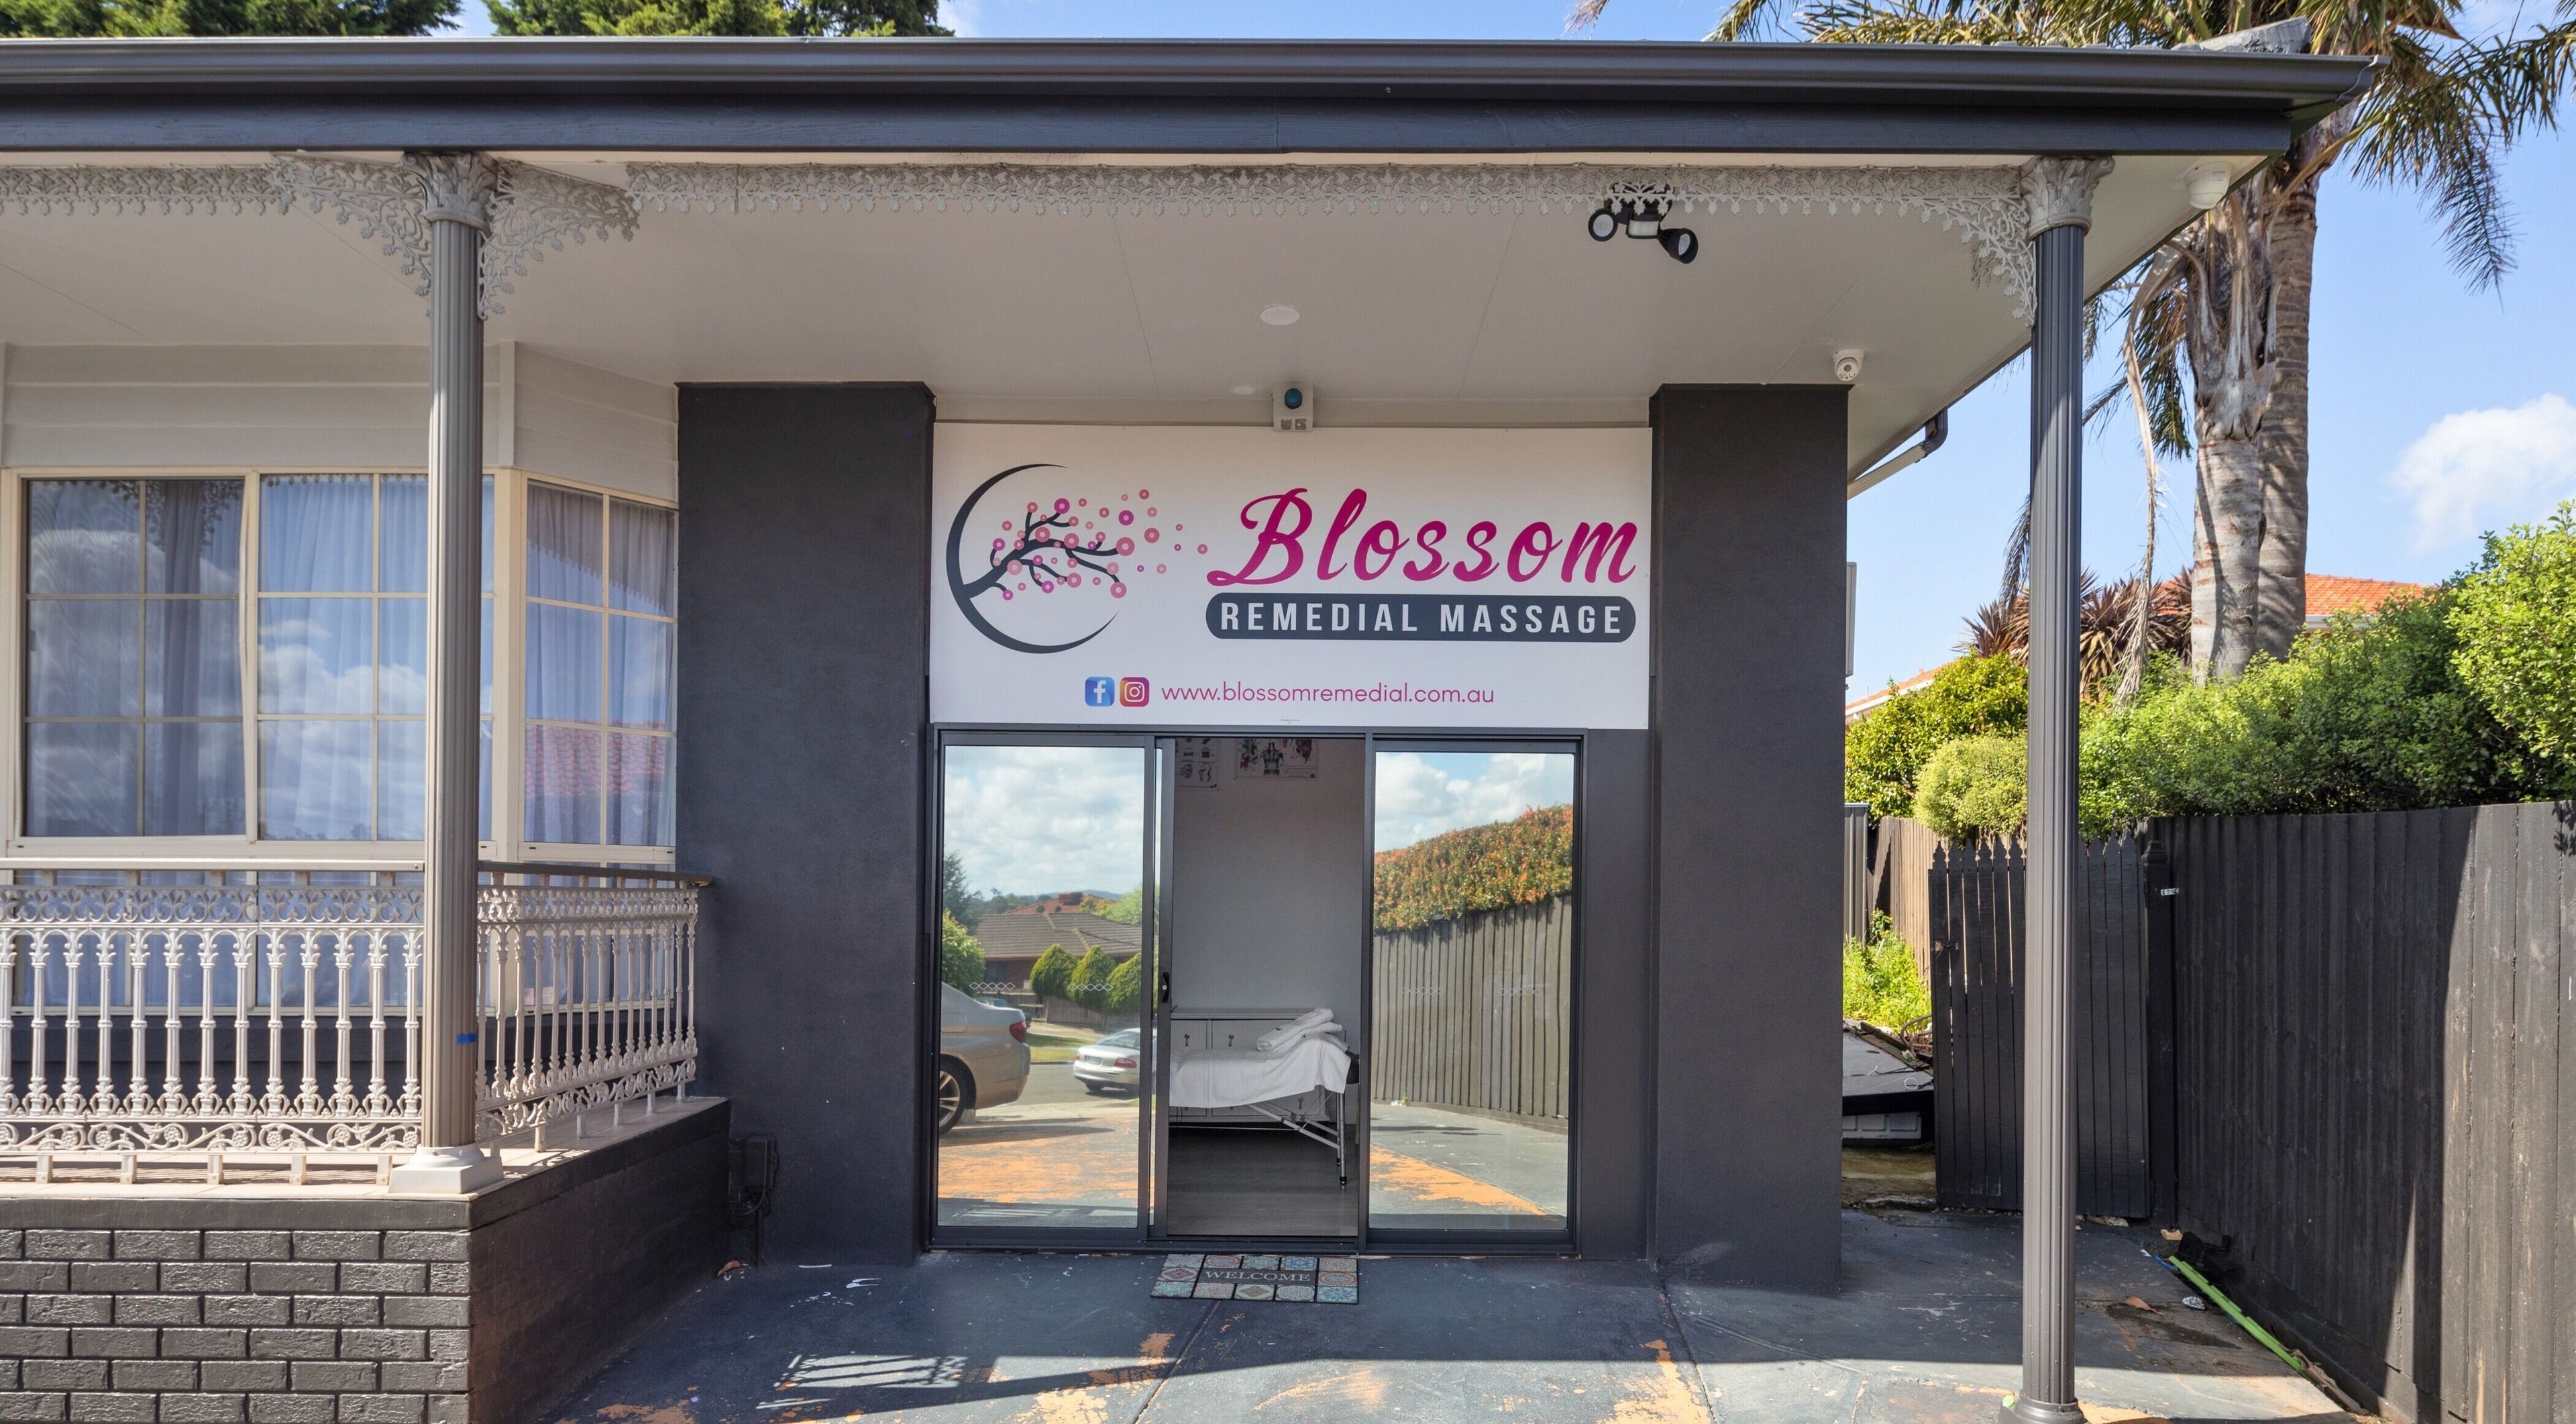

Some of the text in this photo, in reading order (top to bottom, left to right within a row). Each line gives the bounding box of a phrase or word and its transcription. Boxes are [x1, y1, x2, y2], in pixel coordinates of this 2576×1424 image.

[1206, 486, 1638, 587] Blossom
[1220, 602, 1621, 634] REMEDIAL MASSAGE
[1161, 681, 1495, 704] www.blossomremedial.com.au
[1205, 1270, 1311, 1282] WELCOME
